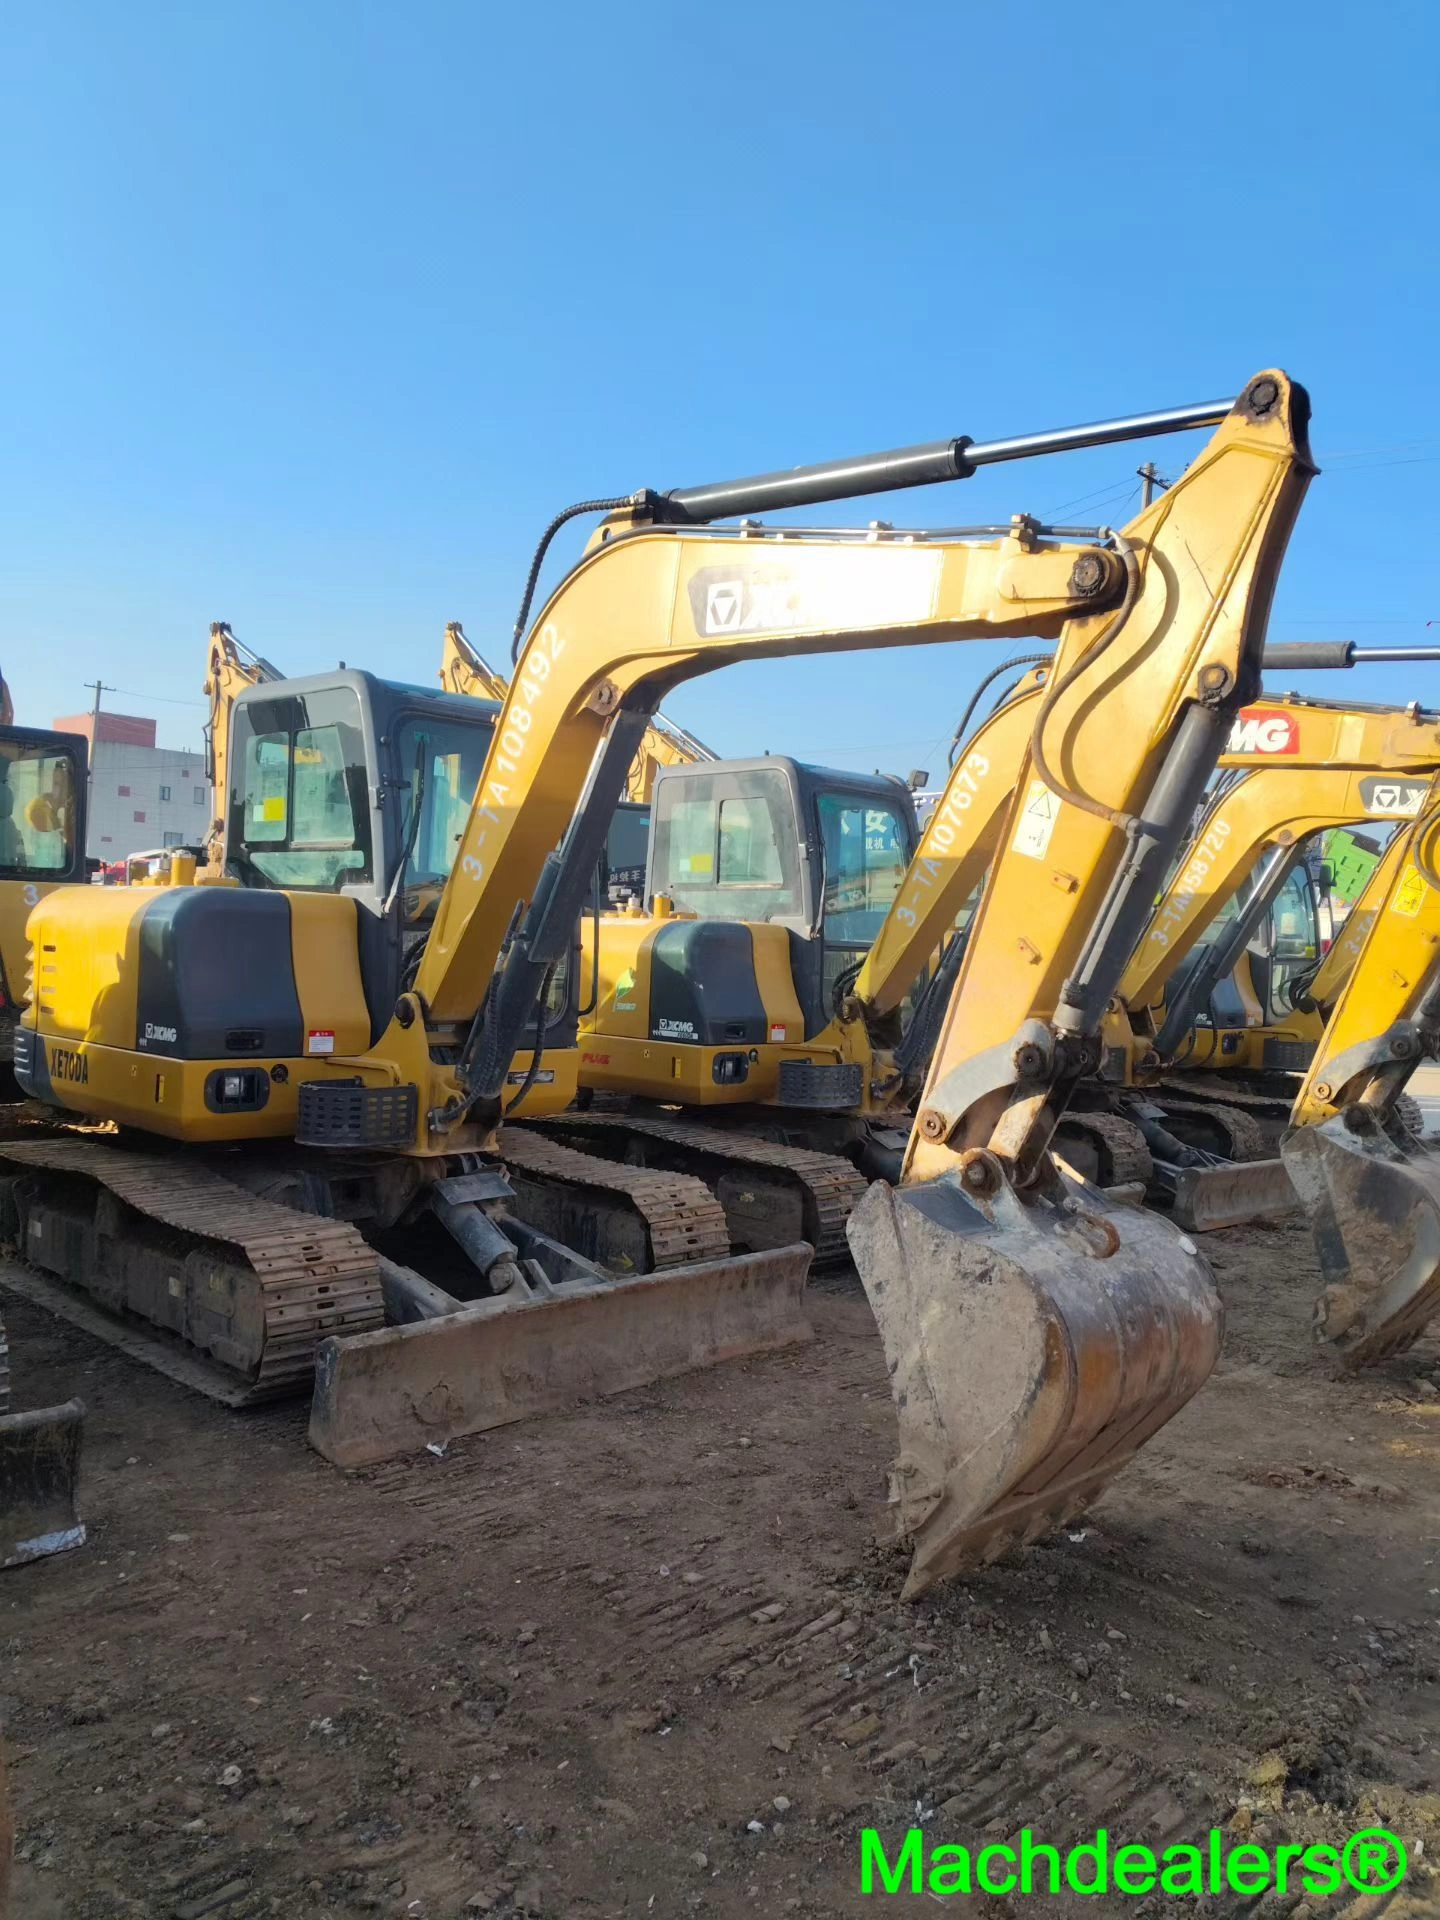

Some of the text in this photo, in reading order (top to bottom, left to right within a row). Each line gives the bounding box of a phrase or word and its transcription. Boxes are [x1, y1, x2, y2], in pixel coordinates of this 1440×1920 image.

[1226, 717, 1290, 752] MG
[897, 752, 990, 928] 3-TA107673
[51, 1047, 88, 1084] XE70DA
